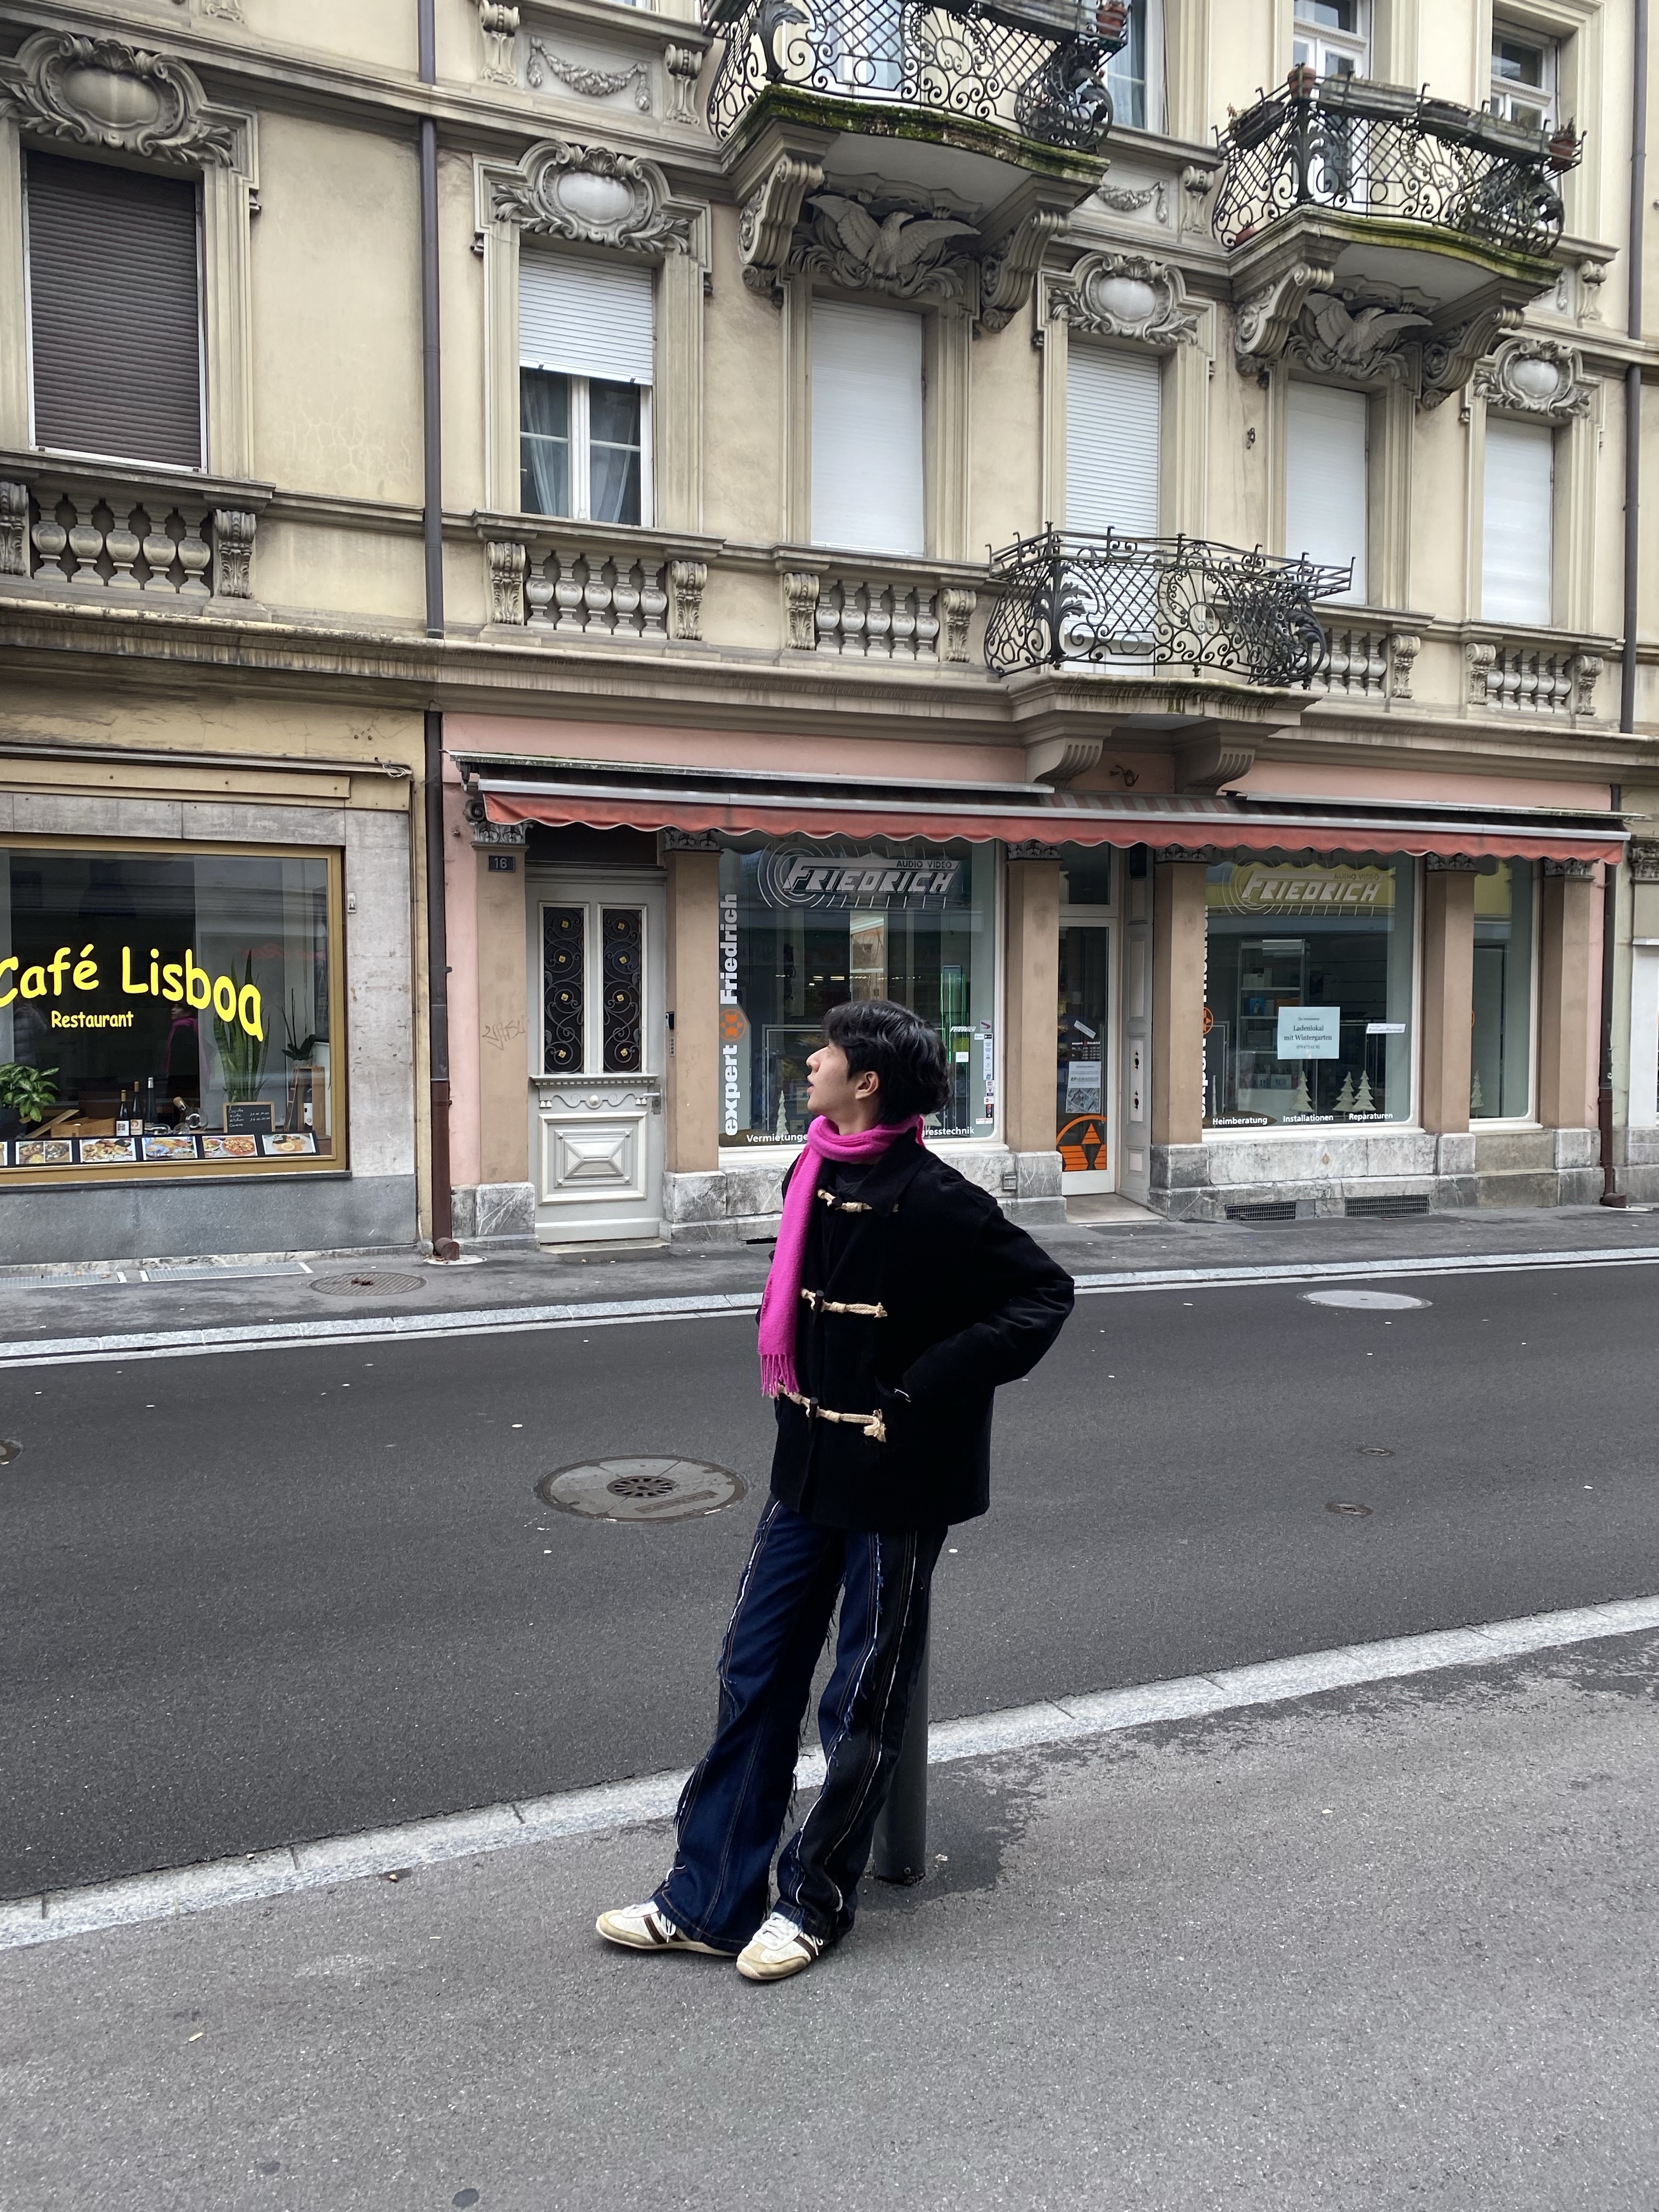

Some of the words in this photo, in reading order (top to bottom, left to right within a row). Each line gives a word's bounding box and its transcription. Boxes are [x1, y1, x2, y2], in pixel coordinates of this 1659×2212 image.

[494, 857, 507, 869] 16
[782, 857, 955, 894] FRIEDRICH
[1241, 870, 1381, 902] FRIEDRICH
[720, 894, 738, 1004] Friedrich
[0, 944, 99, 1007] Café
[122, 946, 263, 1042] Lisboa
[52, 1011, 134, 1028] Restaurant
[723, 1045, 741, 1136] expert
[1212, 1117, 1267, 1125] Heimberatung
[746, 1133, 808, 1142] Vermietunge
